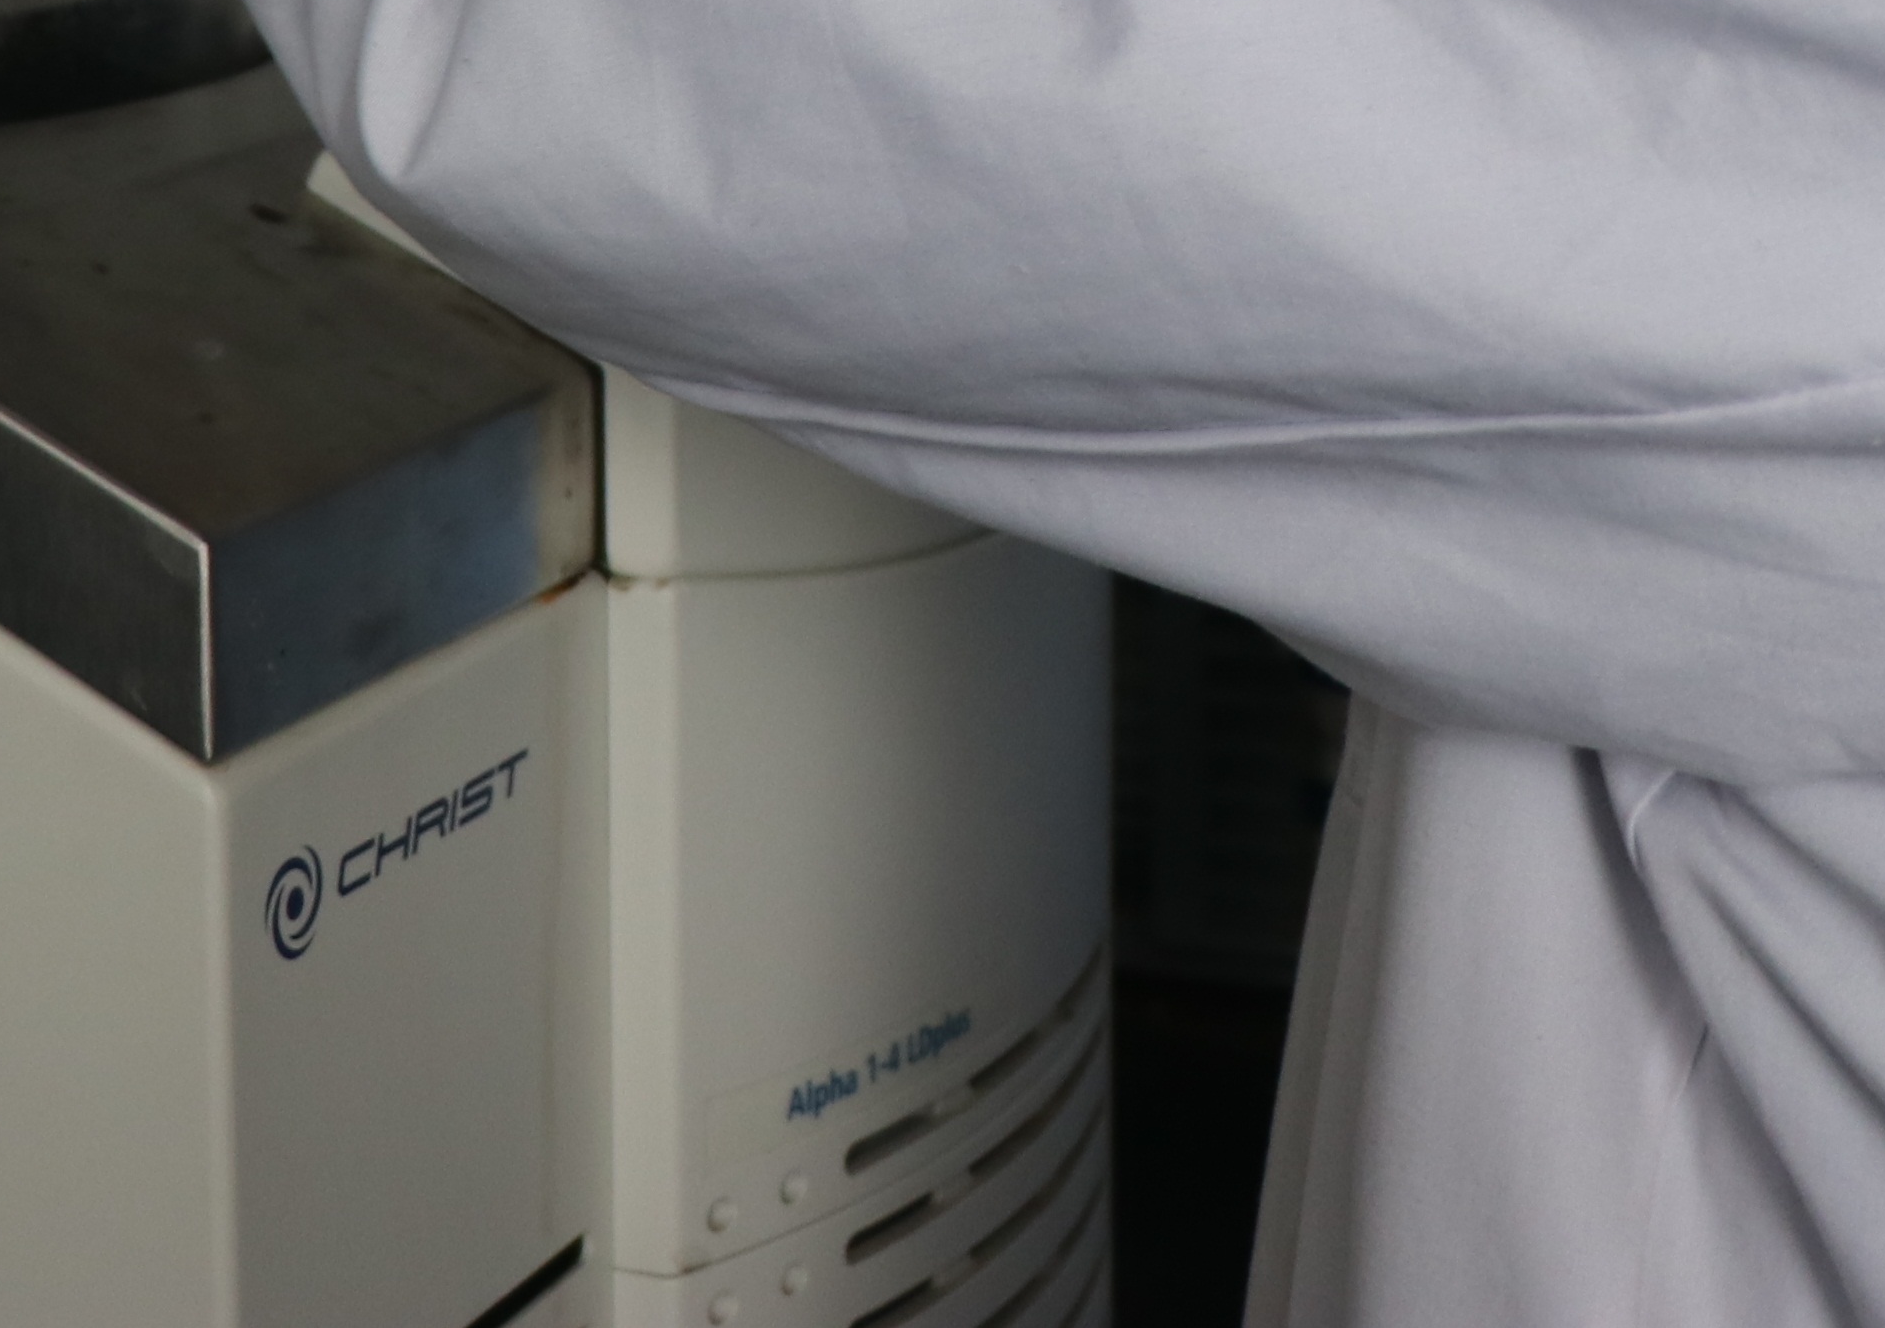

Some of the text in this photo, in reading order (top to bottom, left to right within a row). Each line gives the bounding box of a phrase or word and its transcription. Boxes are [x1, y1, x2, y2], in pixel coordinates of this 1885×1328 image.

[337, 748, 529, 897] CHRIST
[787, 1068, 859, 1121] Alpha
[868, 1041, 901, 1084] 1-4
